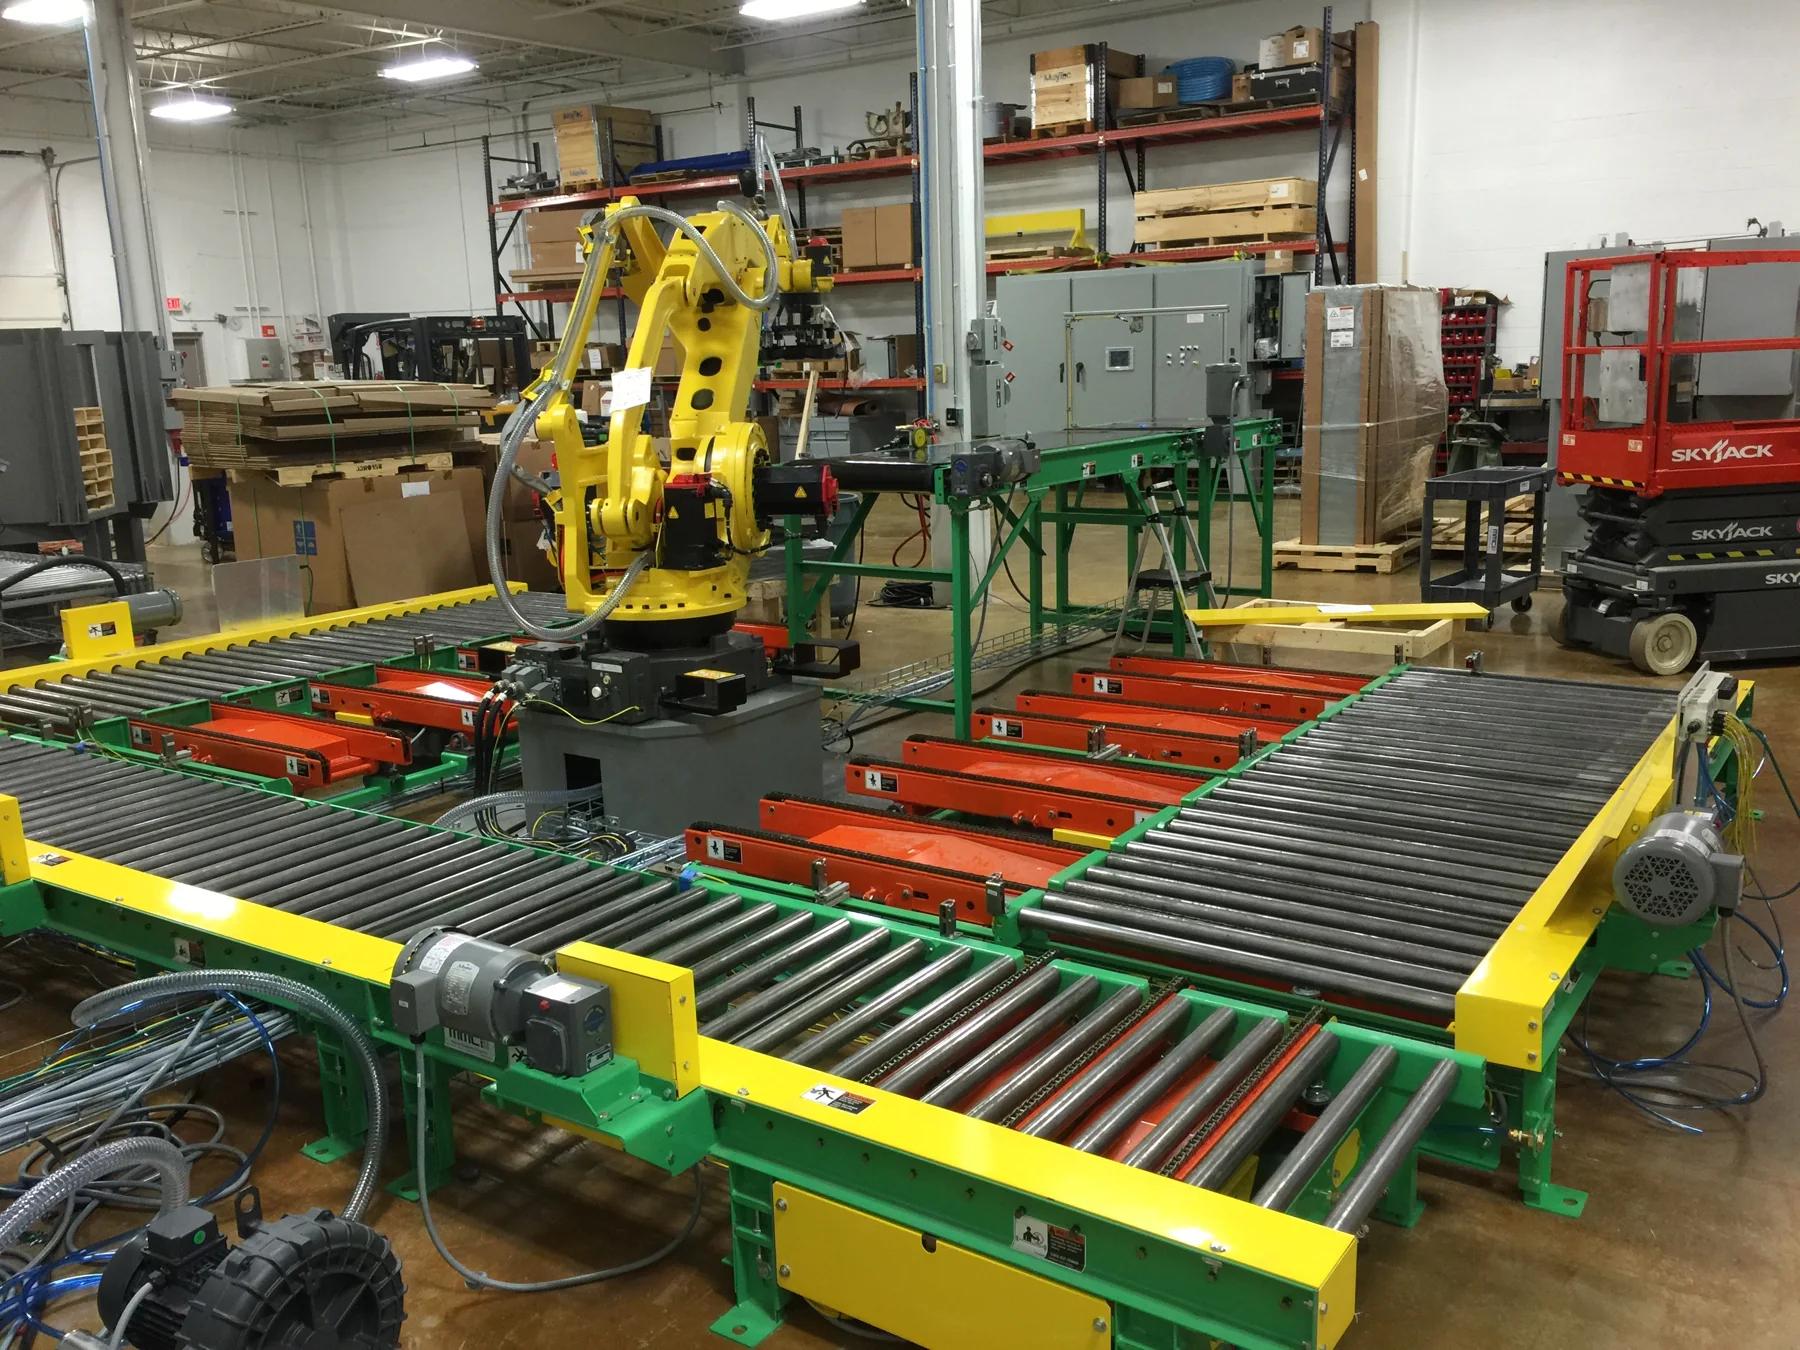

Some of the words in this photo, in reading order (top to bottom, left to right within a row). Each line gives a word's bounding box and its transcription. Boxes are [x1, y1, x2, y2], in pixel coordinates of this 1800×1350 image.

[167, 298, 180, 309] EXIT
[1671, 439, 1774, 464] SKYJACK
[1691, 522, 1773, 542] SKYJACK
